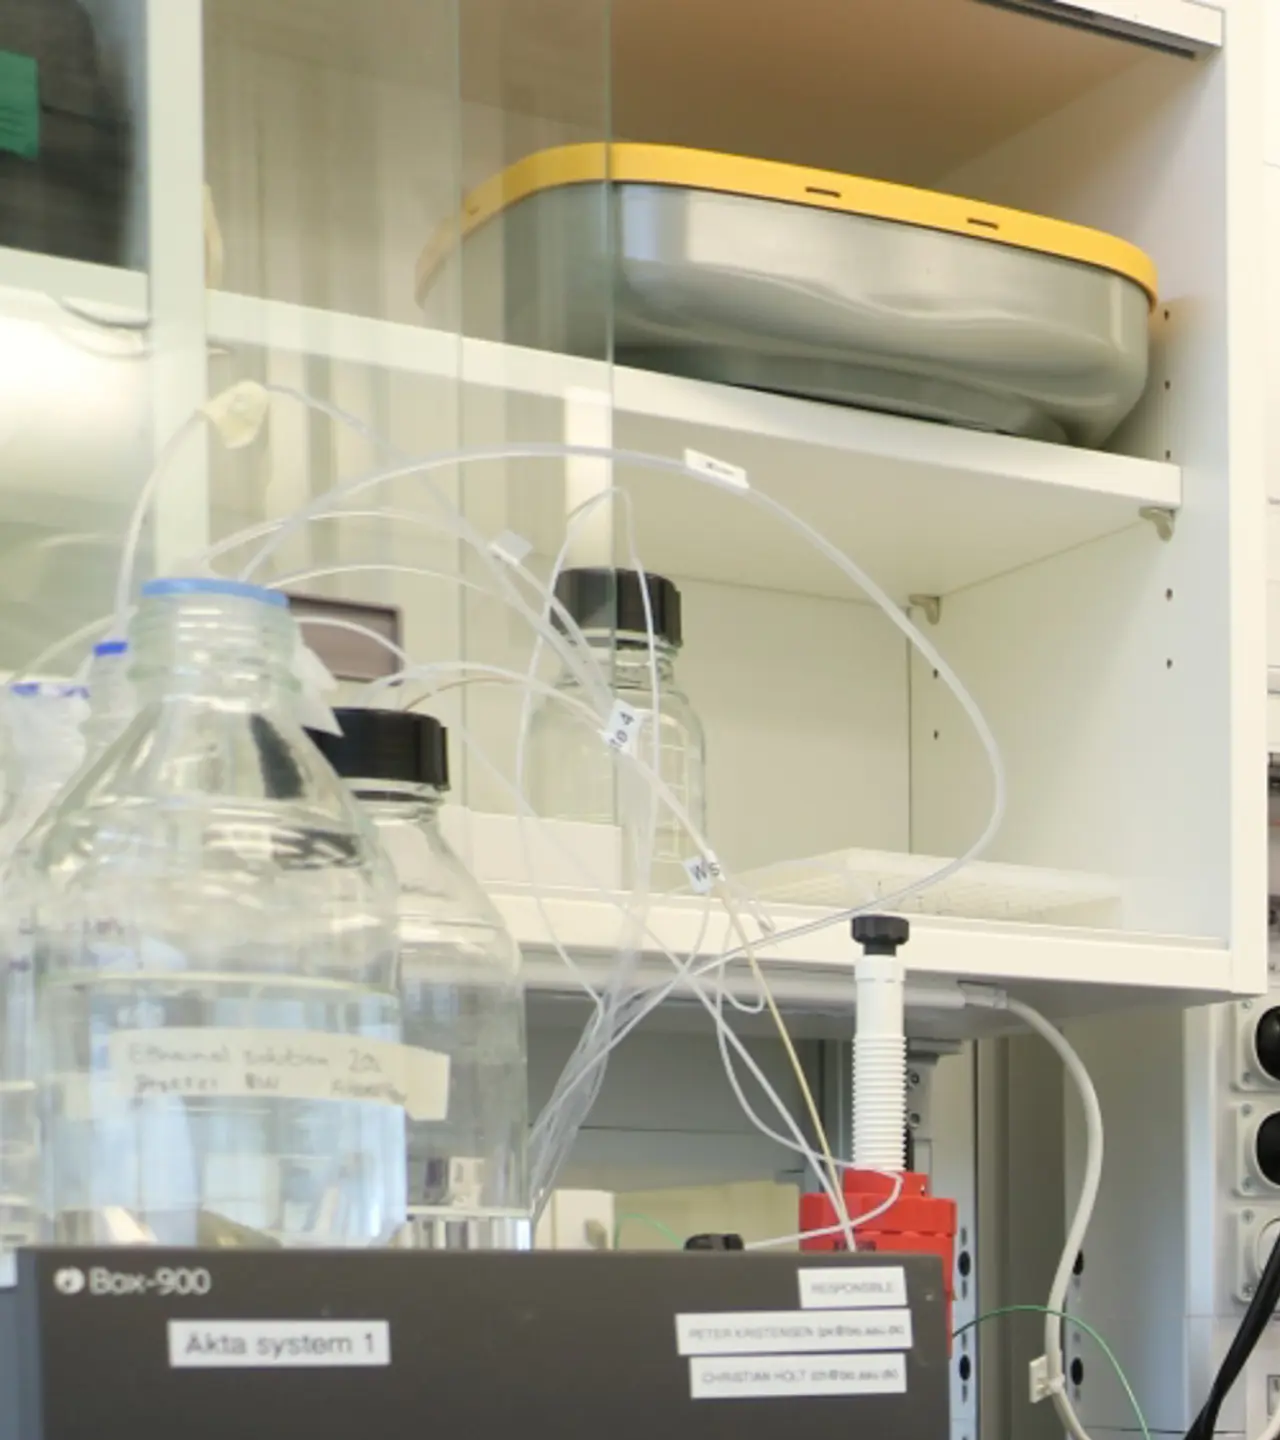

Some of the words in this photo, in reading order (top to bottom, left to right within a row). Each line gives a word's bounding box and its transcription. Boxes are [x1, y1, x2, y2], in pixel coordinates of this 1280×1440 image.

[89, 1267, 212, 1295] Box-900
[256, 1334, 353, 1359] system
[364, 1332, 376, 1354] 1
